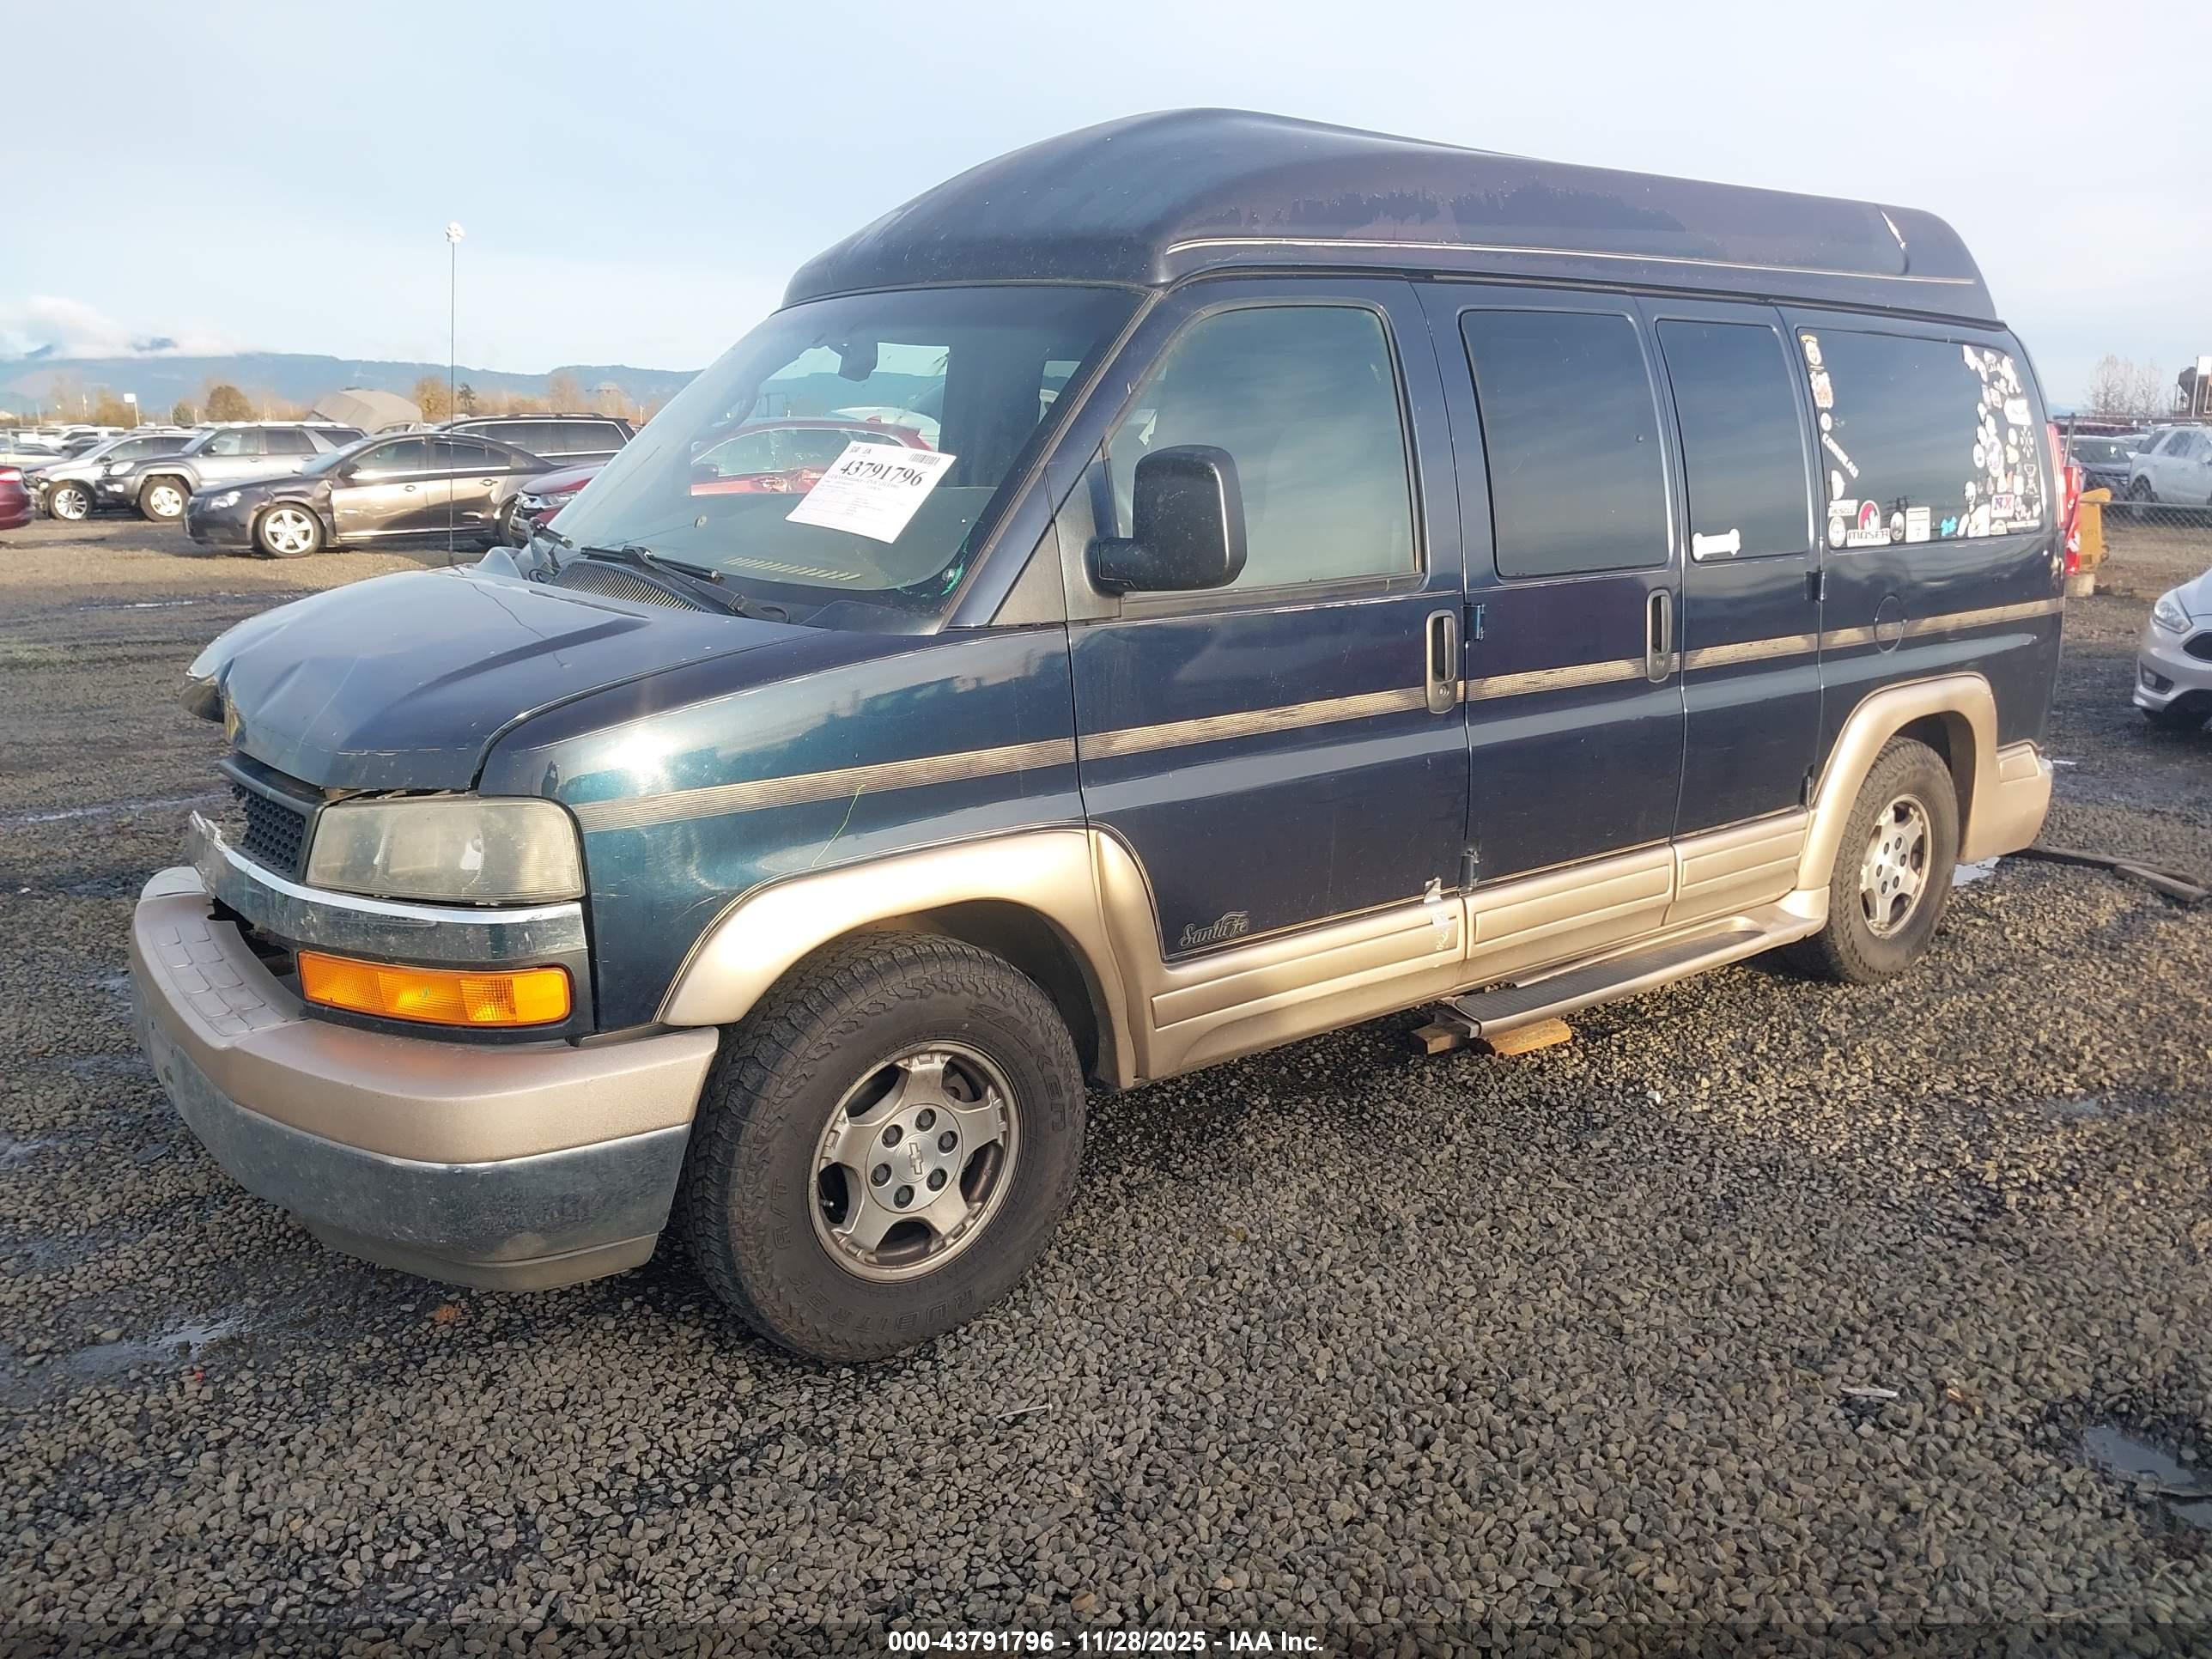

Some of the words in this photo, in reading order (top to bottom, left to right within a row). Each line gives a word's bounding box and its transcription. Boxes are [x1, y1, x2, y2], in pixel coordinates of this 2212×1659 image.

[840, 460, 928, 487] 43791796
[1179, 921, 1227, 948] Santa
[1223, 911, 1249, 937] Fe
